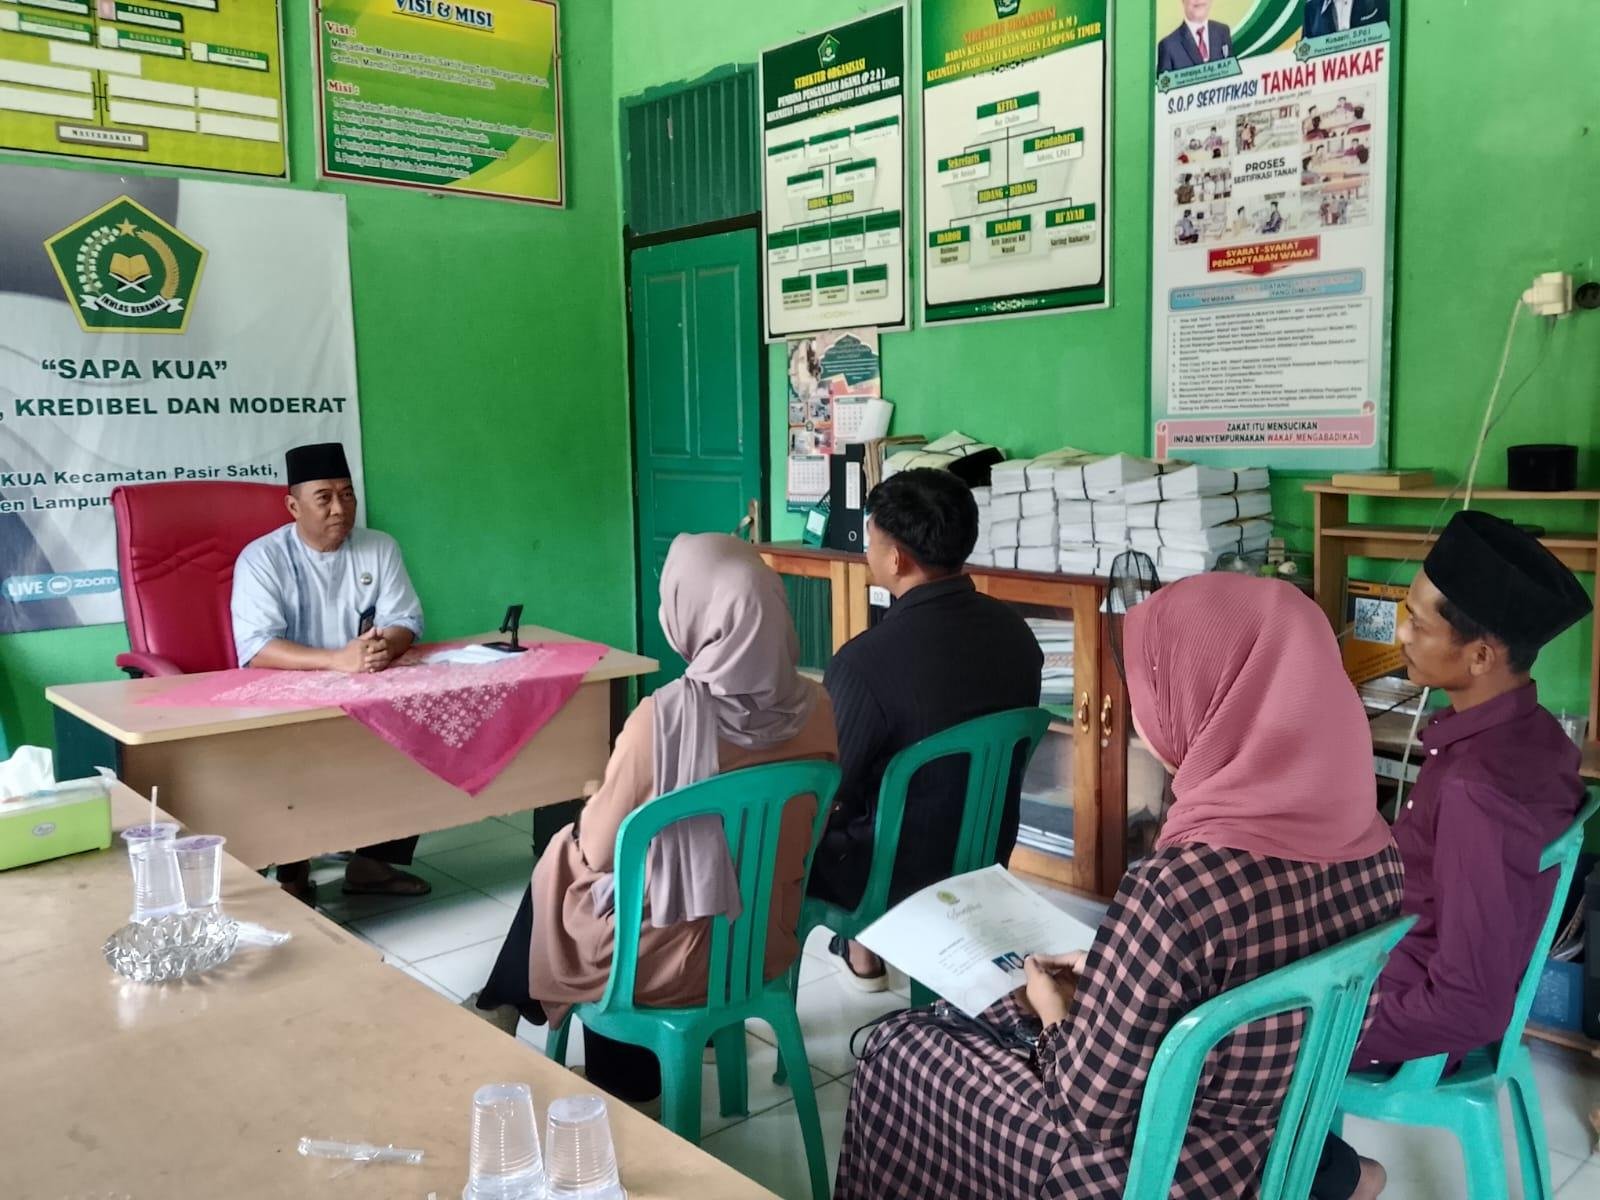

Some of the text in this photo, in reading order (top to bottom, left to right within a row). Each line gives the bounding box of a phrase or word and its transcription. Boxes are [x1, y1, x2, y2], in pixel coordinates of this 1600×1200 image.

[395, 0, 493, 27] VISI & MISI
[326, 22, 349, 35] Visi
[1042, 30, 1076, 49] LAMPUNG
[1077, 22, 1102, 39] TIMUR
[328, 80, 352, 93] Misi
[1168, 95, 1194, 114] S.O.P
[1196, 80, 1259, 108] SERTIFIKASI
[1261, 65, 1317, 96] TANAH
[1321, 48, 1384, 79] WAKAF
[1035, 132, 1076, 149] Bendahara
[1245, 157, 1286, 172] PROSES
[1233, 167, 1298, 185] SERTIFIKASI TANAH
[1212, 249, 1315, 268] PENDAFTARAN WAKAF
[1226, 242, 1299, 258] SYARAT-SYARAT
[101, 296, 165, 314] IKHLAS BERAMAL
[15, 397, 347, 417] KREDIBEL DAN MODERAT
[1227, 421, 1318, 432] ZAKAT ITU MENSUCIKAN
[1173, 431, 1360, 443] INFAQ MENYEMPURNAKAN WAKAF MENGABADIKAN
[1, 463, 279, 487] KUA Kecamatan Pasir Sakti,
[32, 496, 111, 511] Lampun
[8, 576, 117, 596] LIVE zoom
